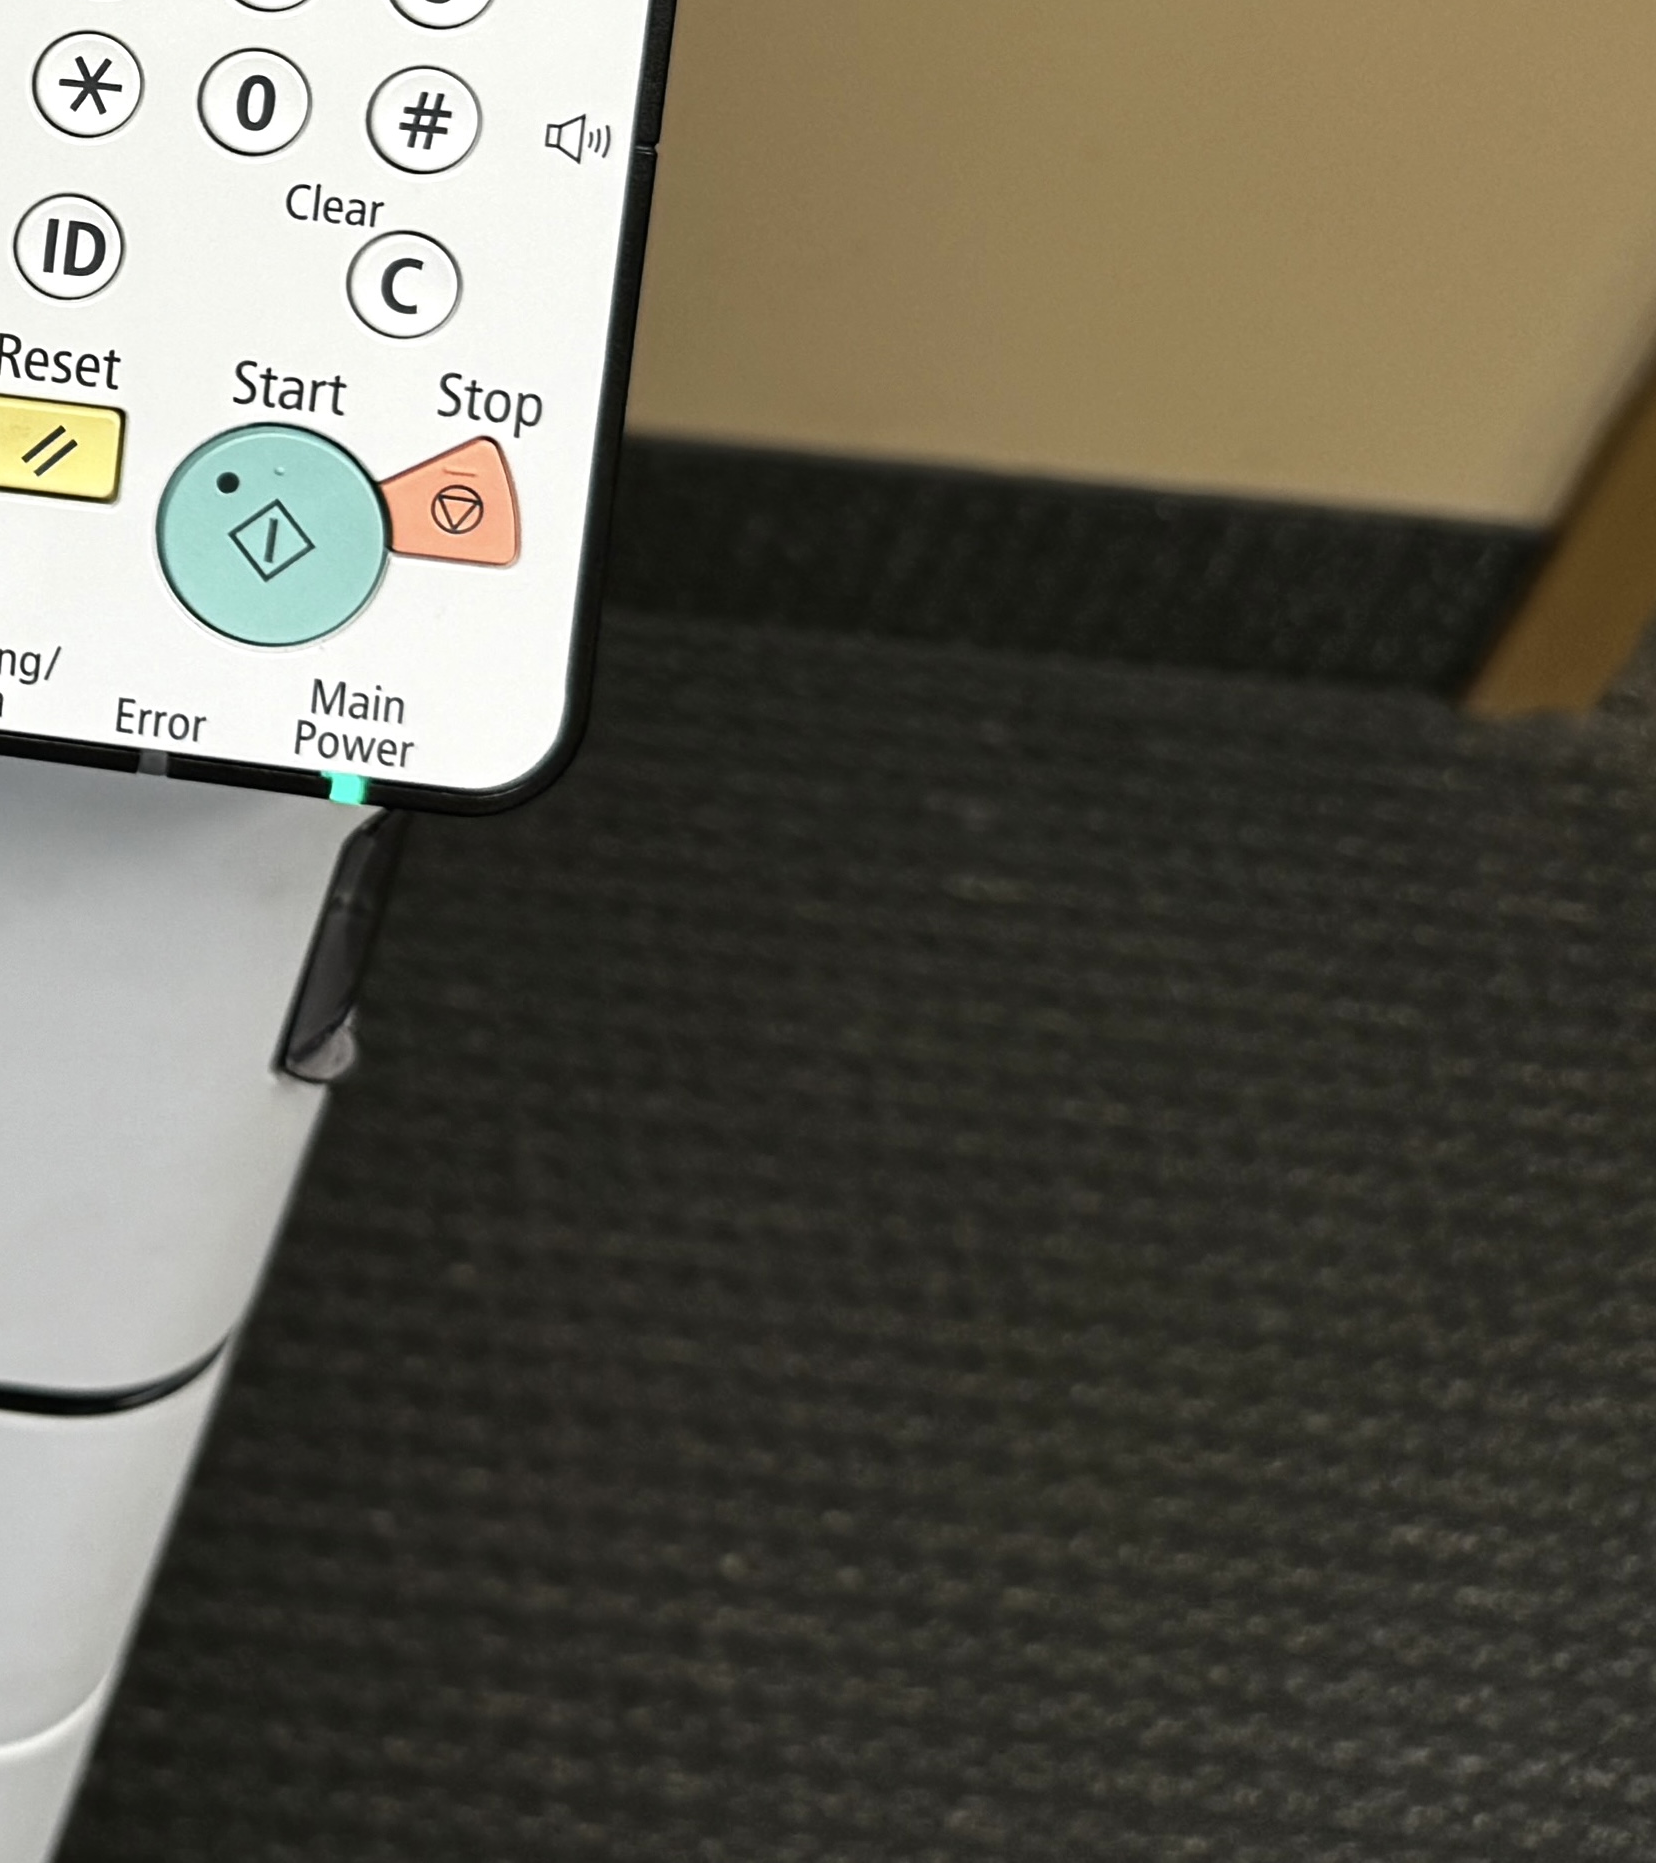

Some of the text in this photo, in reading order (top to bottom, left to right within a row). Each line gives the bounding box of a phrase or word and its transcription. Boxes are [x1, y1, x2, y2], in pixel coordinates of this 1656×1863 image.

[235, 74, 277, 132] 0
[398, 91, 453, 150] #
[285, 184, 386, 228] Clear
[42, 217, 108, 276] ID
[380, 257, 425, 315] C
[232, 360, 348, 417] Start
[436, 372, 544, 440] Stop
[114, 697, 208, 743] Error
[310, 677, 407, 724] Main
[293, 719, 415, 768] Power
